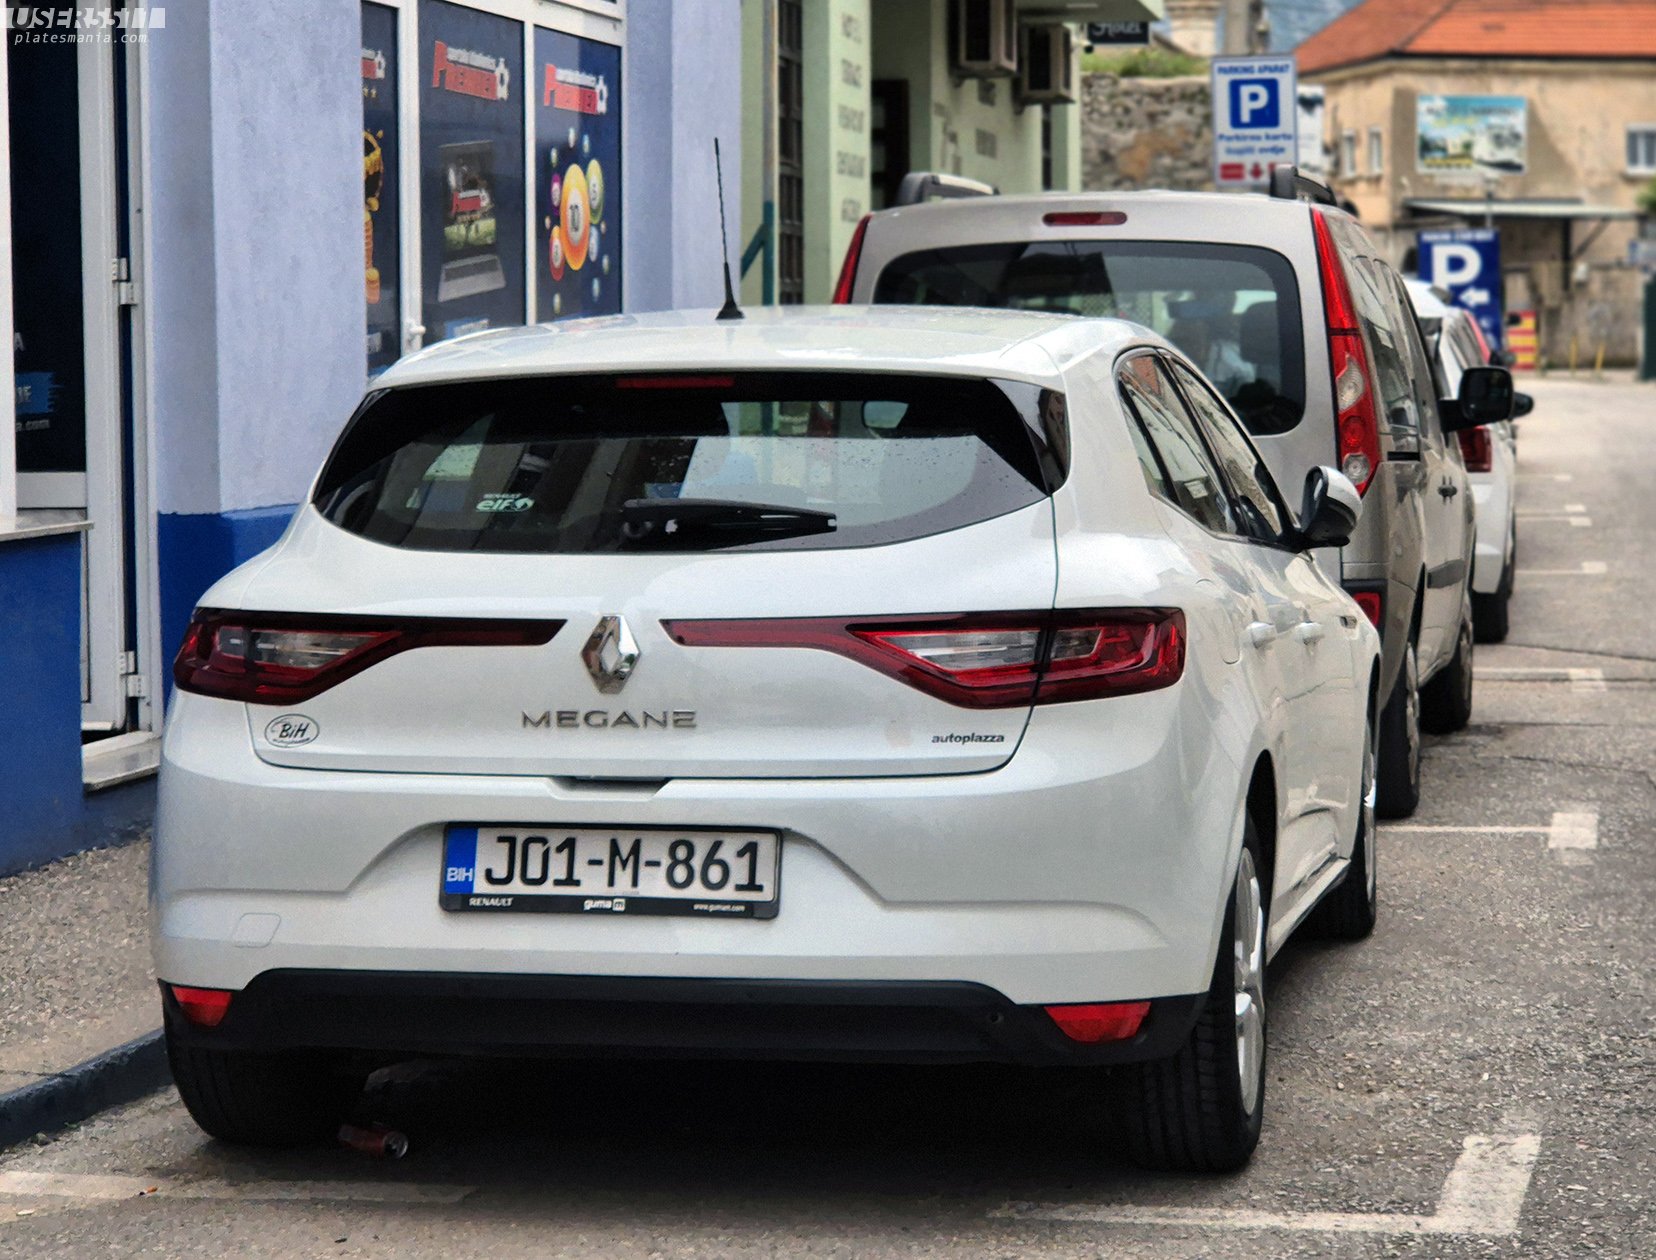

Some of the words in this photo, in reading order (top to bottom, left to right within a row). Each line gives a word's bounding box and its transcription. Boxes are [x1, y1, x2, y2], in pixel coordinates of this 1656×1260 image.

[1217, 65, 1255, 75] PARKING
[1240, 84, 1269, 123] P
[1431, 244, 1482, 290] P
[522, 710, 698, 729] MEGANE
[279, 722, 311, 739] BiH
[931, 732, 1005, 745] autoplazza
[484, 835, 765, 893] J01-M-861
[446, 867, 473, 882] BIH
[469, 897, 514, 907] RENAULT
